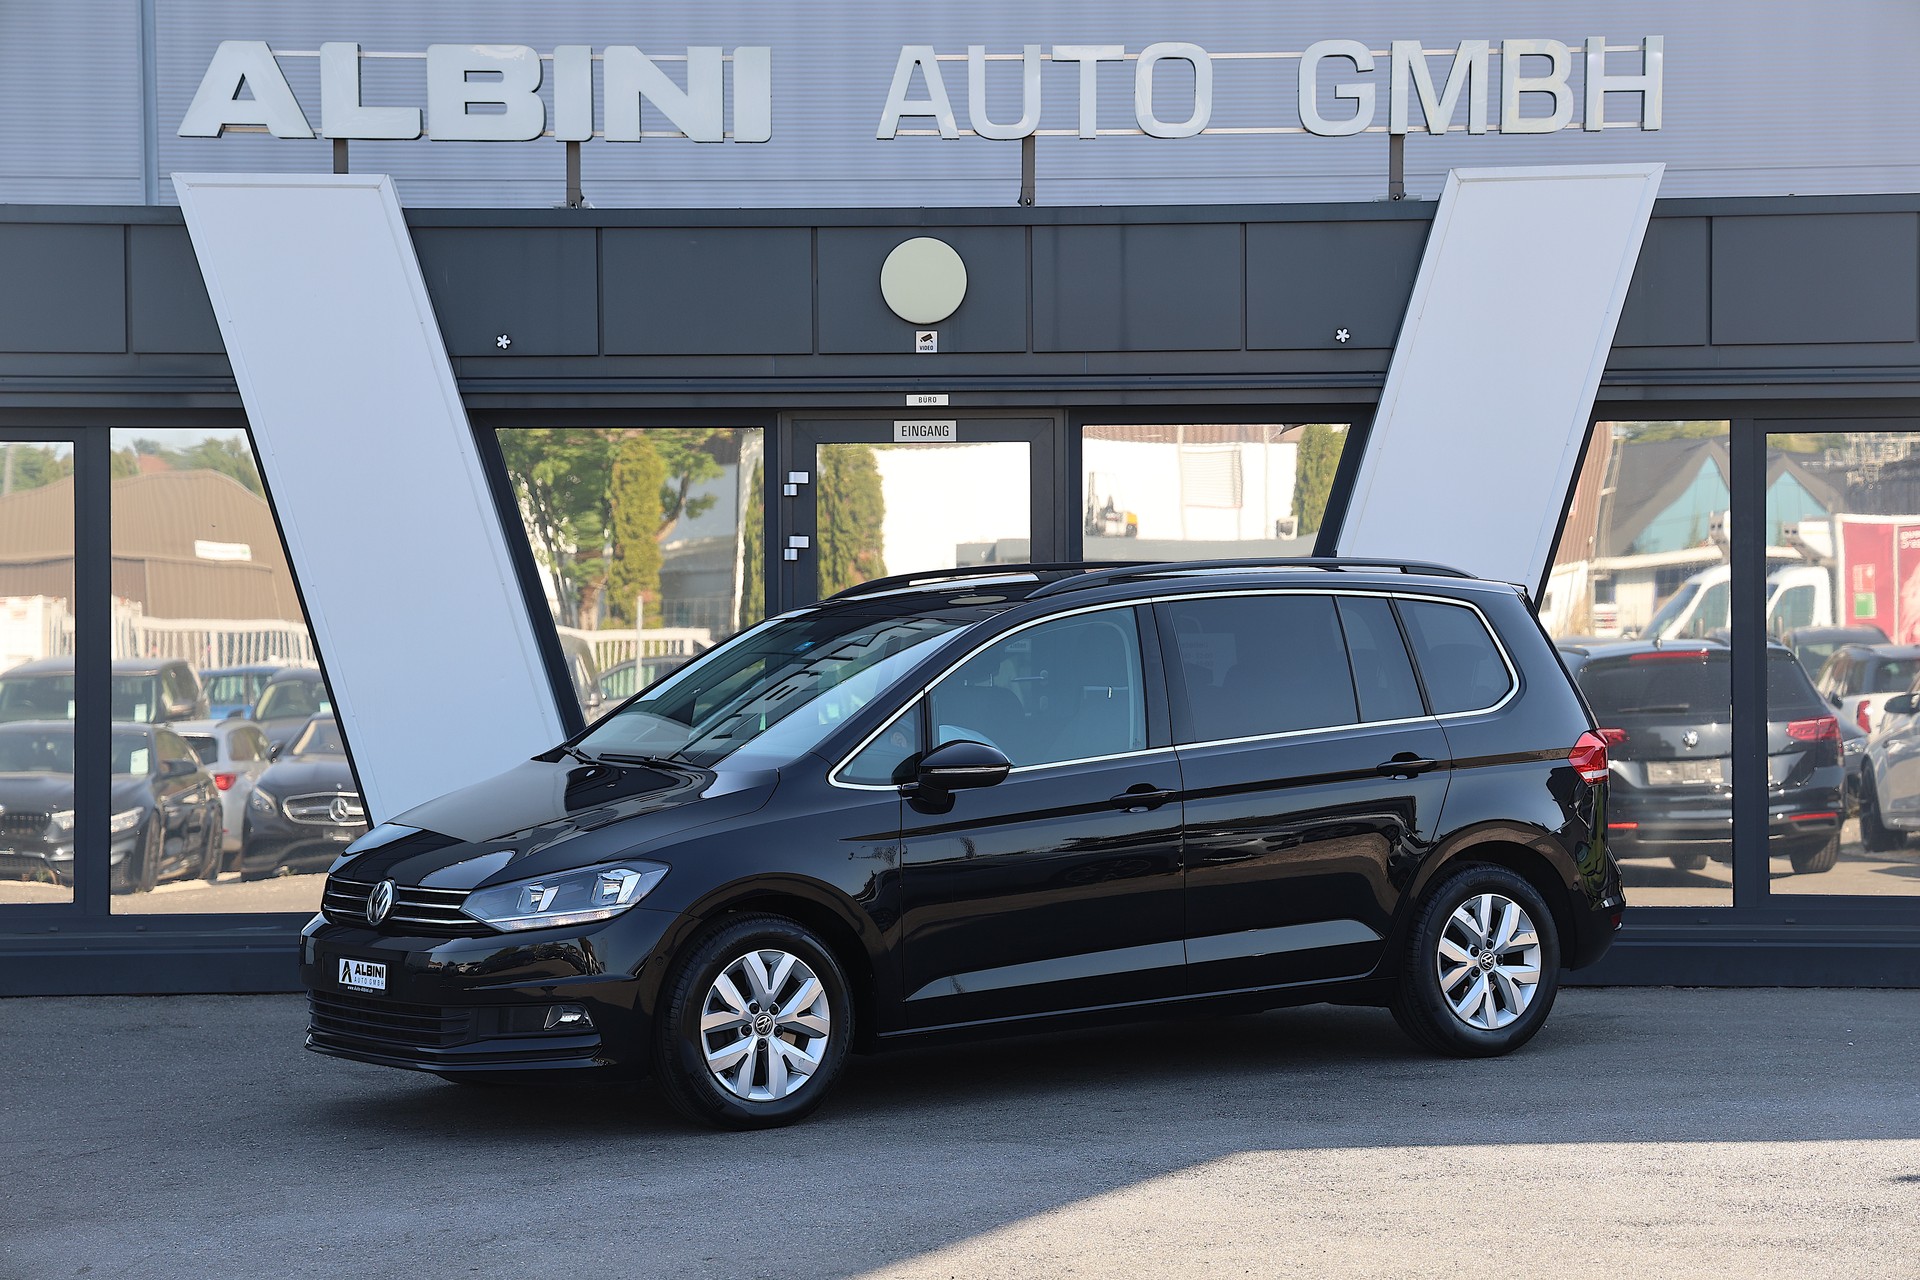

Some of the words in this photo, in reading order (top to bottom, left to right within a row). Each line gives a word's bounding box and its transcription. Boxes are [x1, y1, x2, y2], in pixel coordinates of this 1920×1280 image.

[177, 40, 773, 144] ALBINI
[876, 42, 1214, 140] AUTO
[1297, 34, 1664, 136] GMBH
[901, 425, 949, 437] EINGANG
[354, 963, 385, 978] ALBINI
[354, 976, 368, 985] AUTO
[369, 979, 384, 987] GMBH
